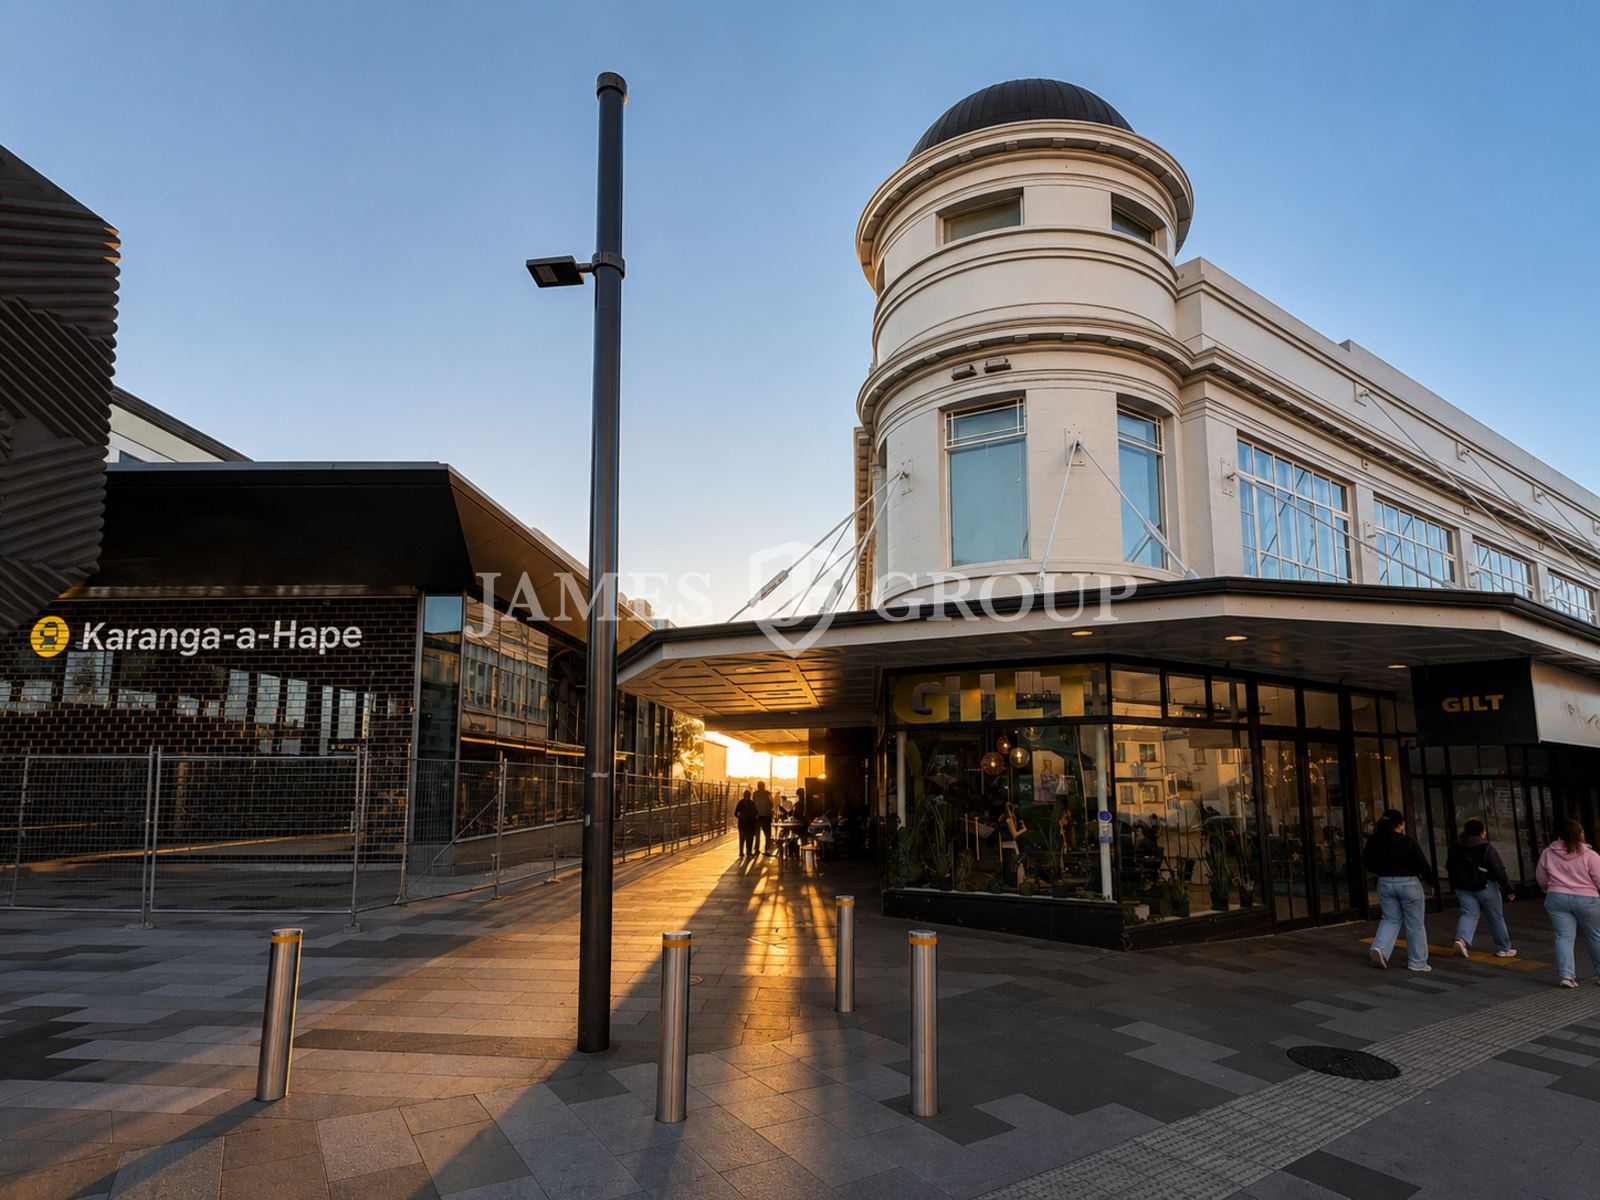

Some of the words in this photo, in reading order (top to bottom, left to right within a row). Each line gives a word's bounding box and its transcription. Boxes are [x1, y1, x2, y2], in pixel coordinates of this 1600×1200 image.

[81, 619, 363, 656] Karanga-a-Hape
[893, 663, 1105, 725] GILT
[1441, 694, 1504, 713] GILT
